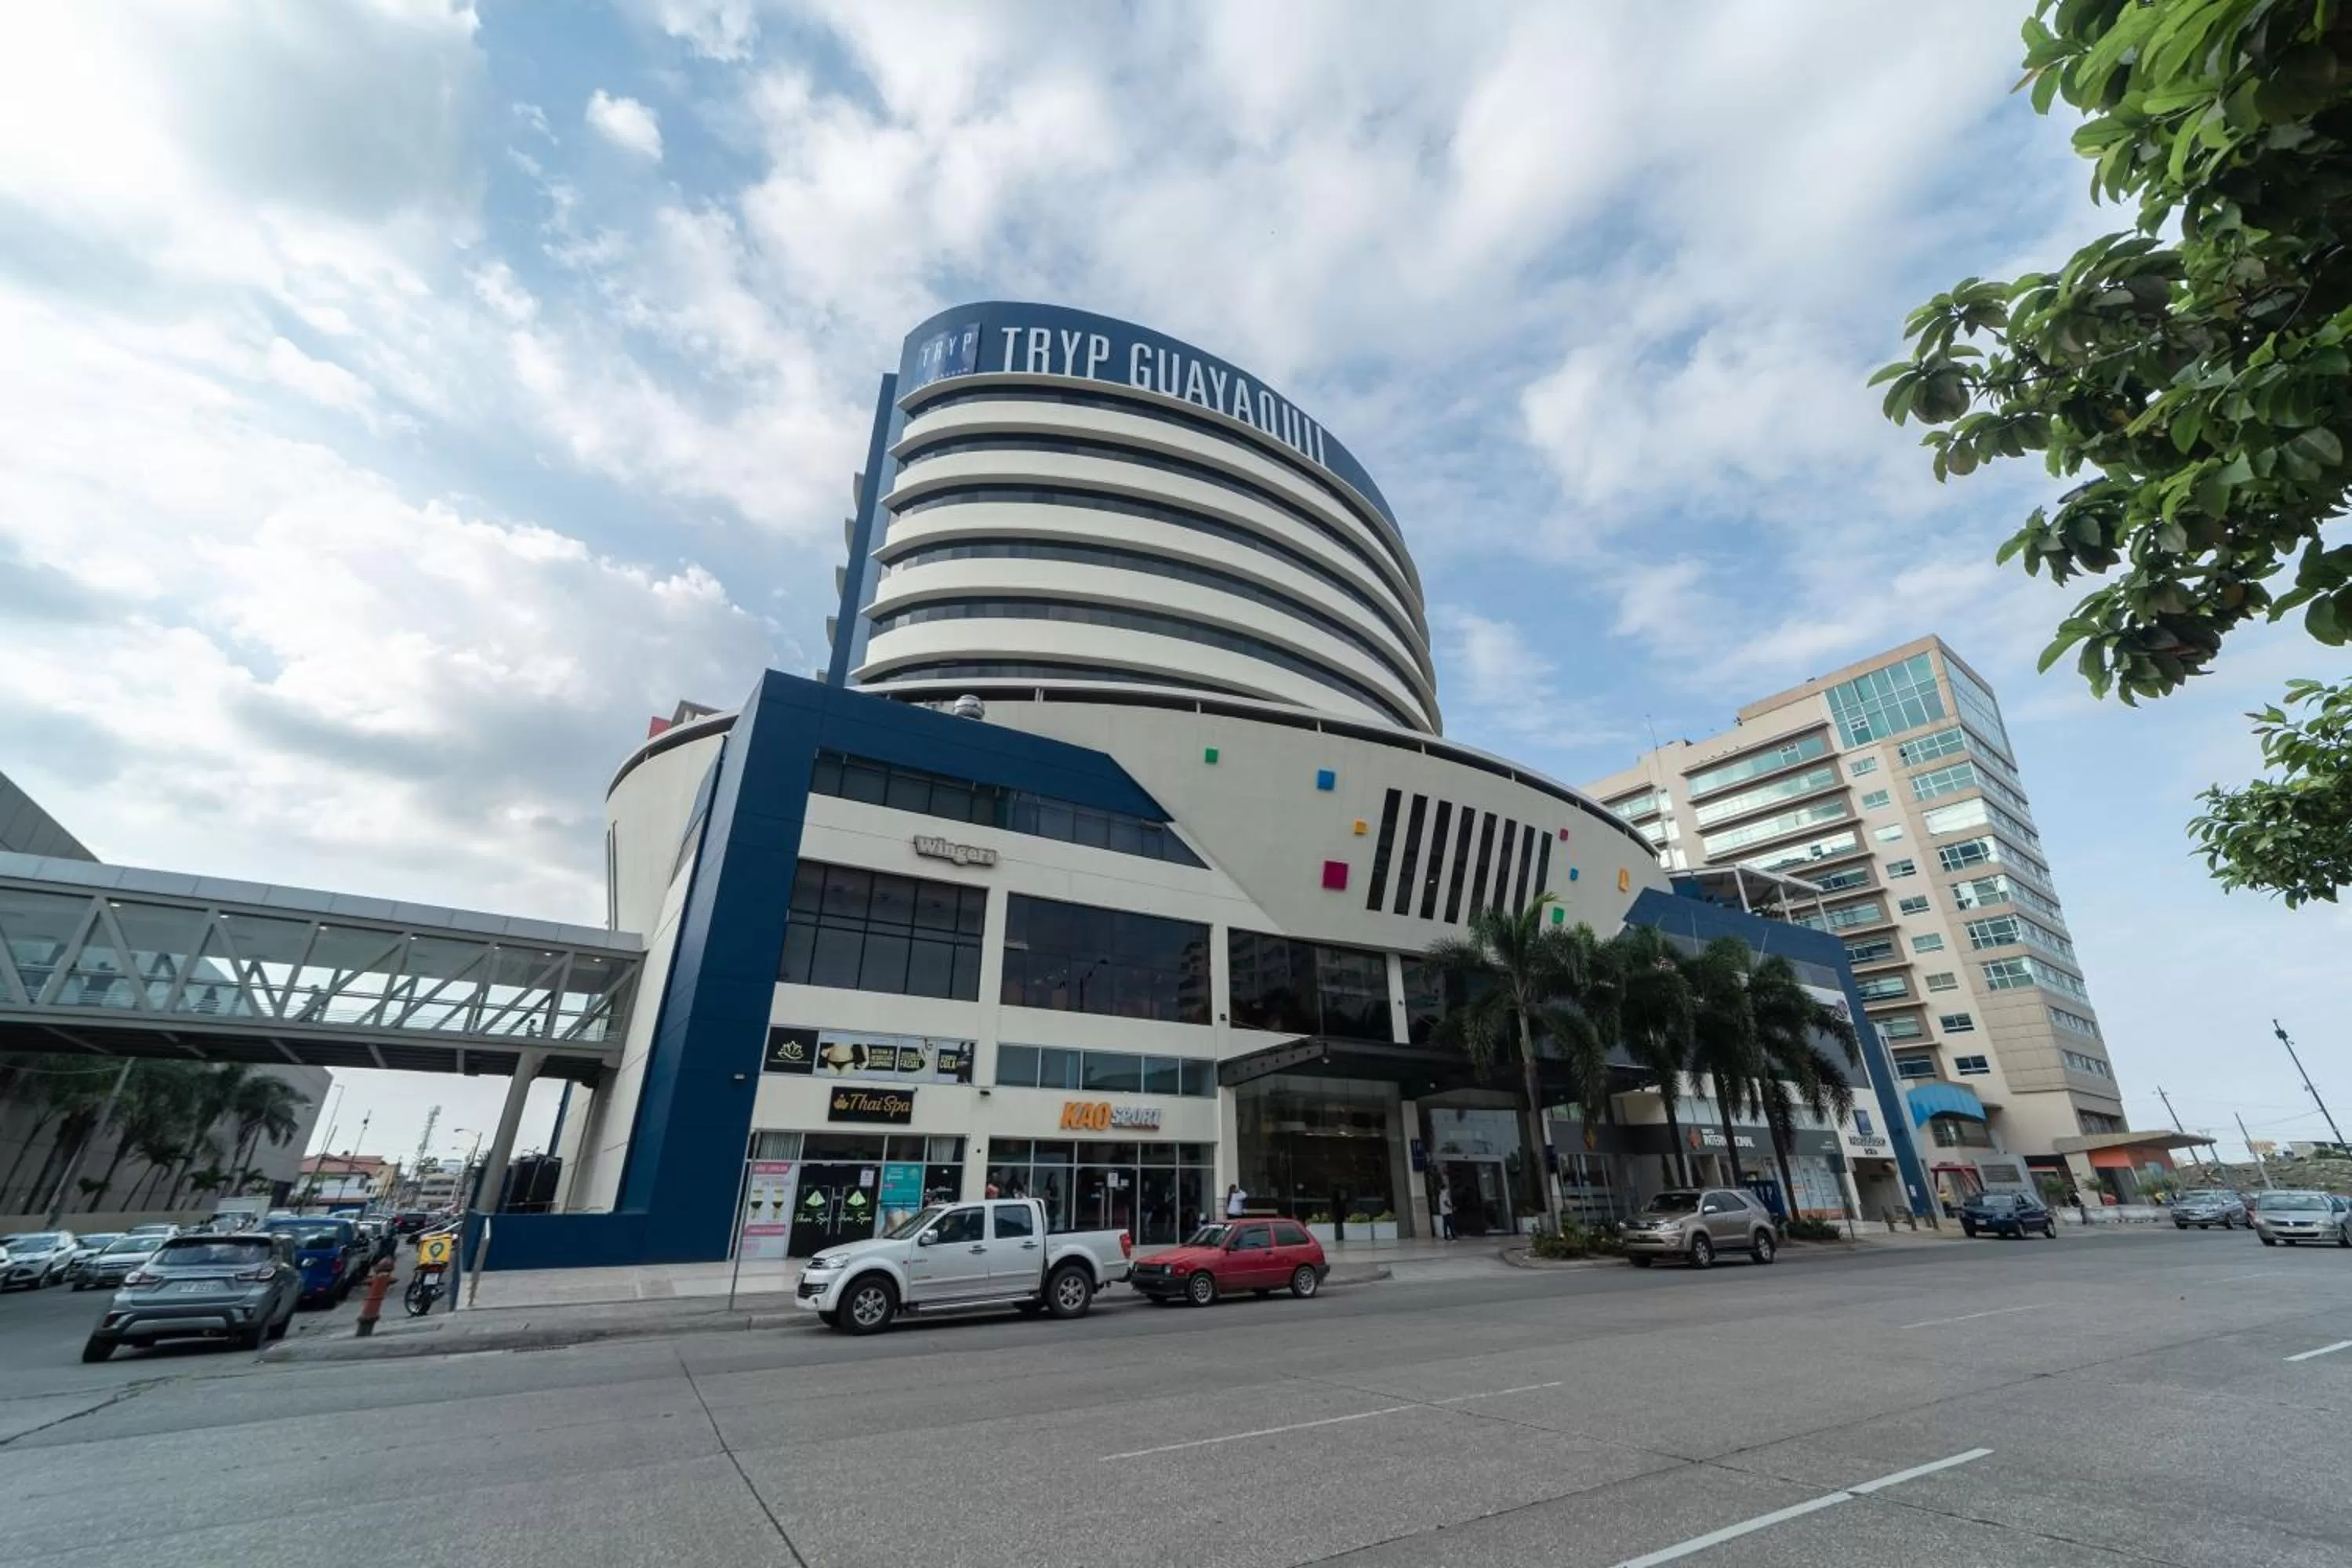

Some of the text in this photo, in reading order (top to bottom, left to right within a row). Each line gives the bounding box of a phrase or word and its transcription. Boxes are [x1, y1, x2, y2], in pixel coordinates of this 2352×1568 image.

[920, 332, 972, 368] TRYP
[1000, 326, 1327, 468] TRYP GUAYAQUIL
[850, 1094, 911, 1119] Thai Spa
[1061, 1102, 1112, 1131] KAO
